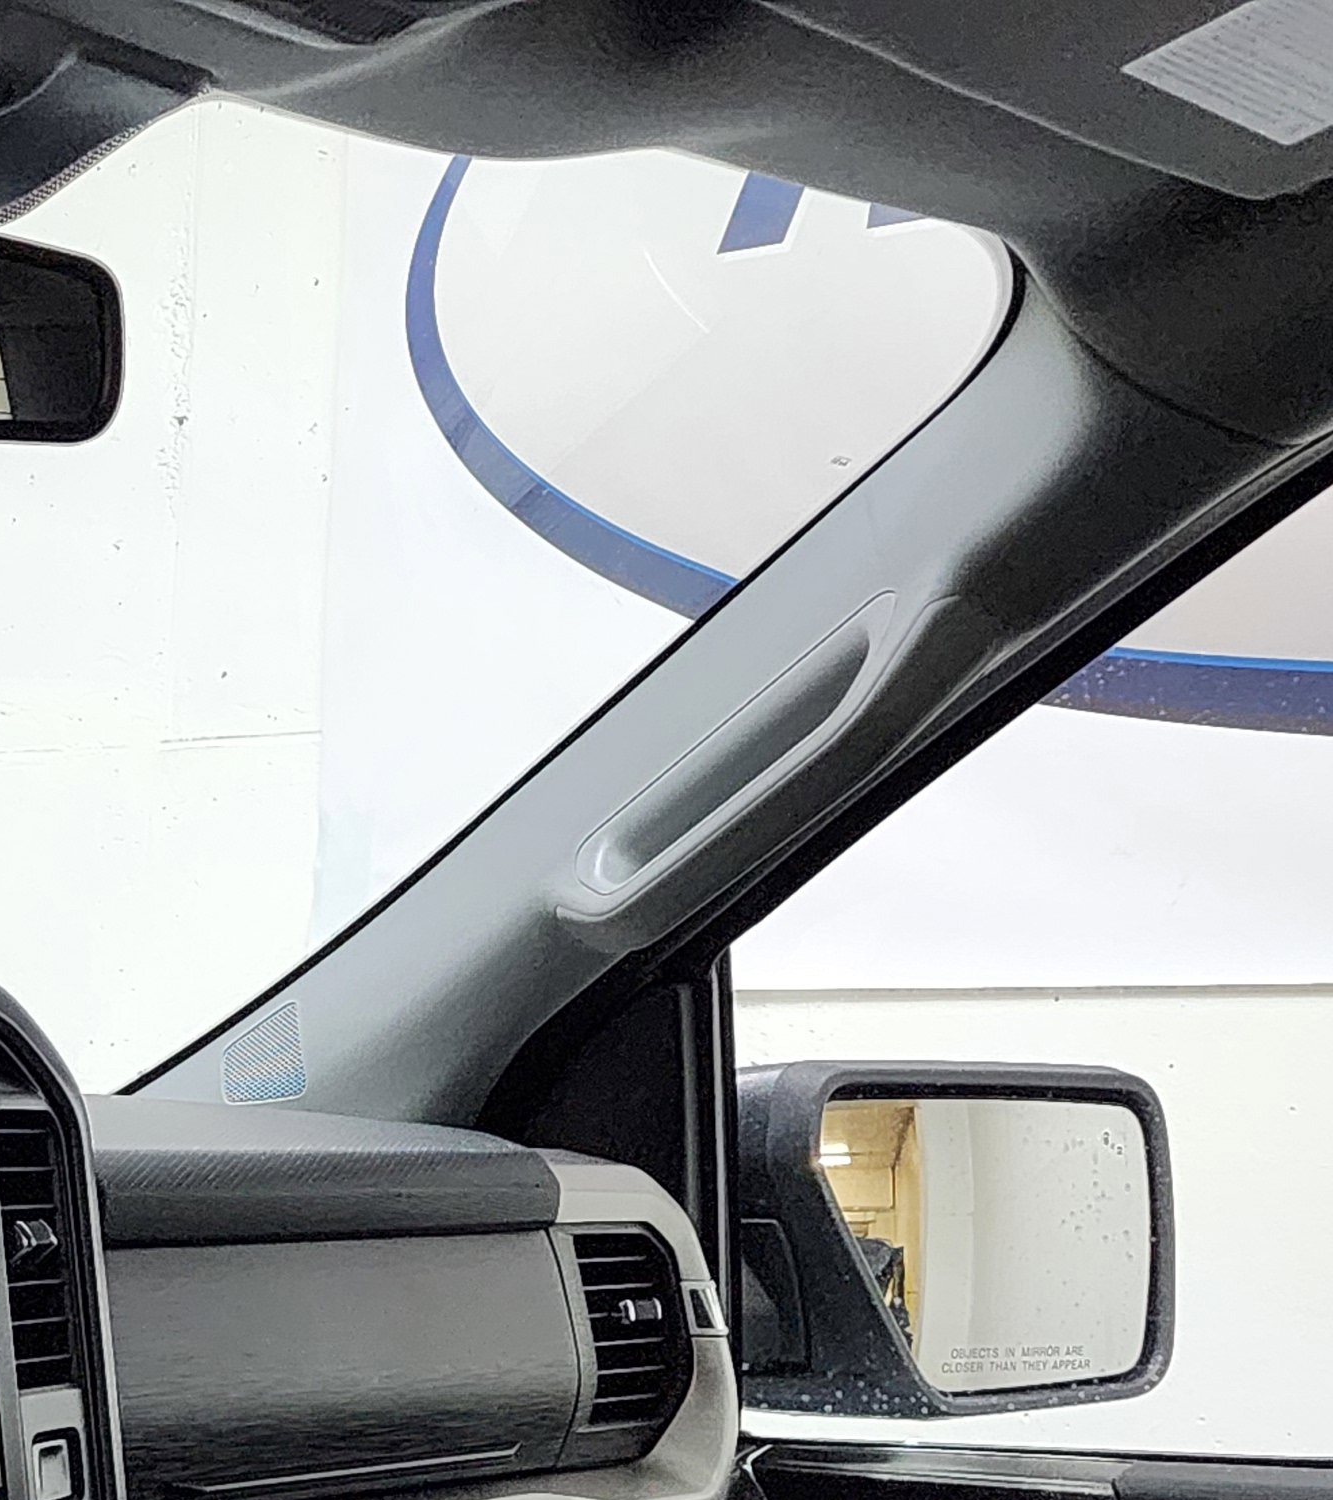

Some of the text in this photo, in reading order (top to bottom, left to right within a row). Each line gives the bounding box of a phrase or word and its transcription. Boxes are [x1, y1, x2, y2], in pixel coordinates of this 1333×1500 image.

[951, 1345, 1085, 1360] OBJECTS IN MIRROR ARE
[941, 1359, 1091, 1374] CLOSER THAN THEY APPEAR
